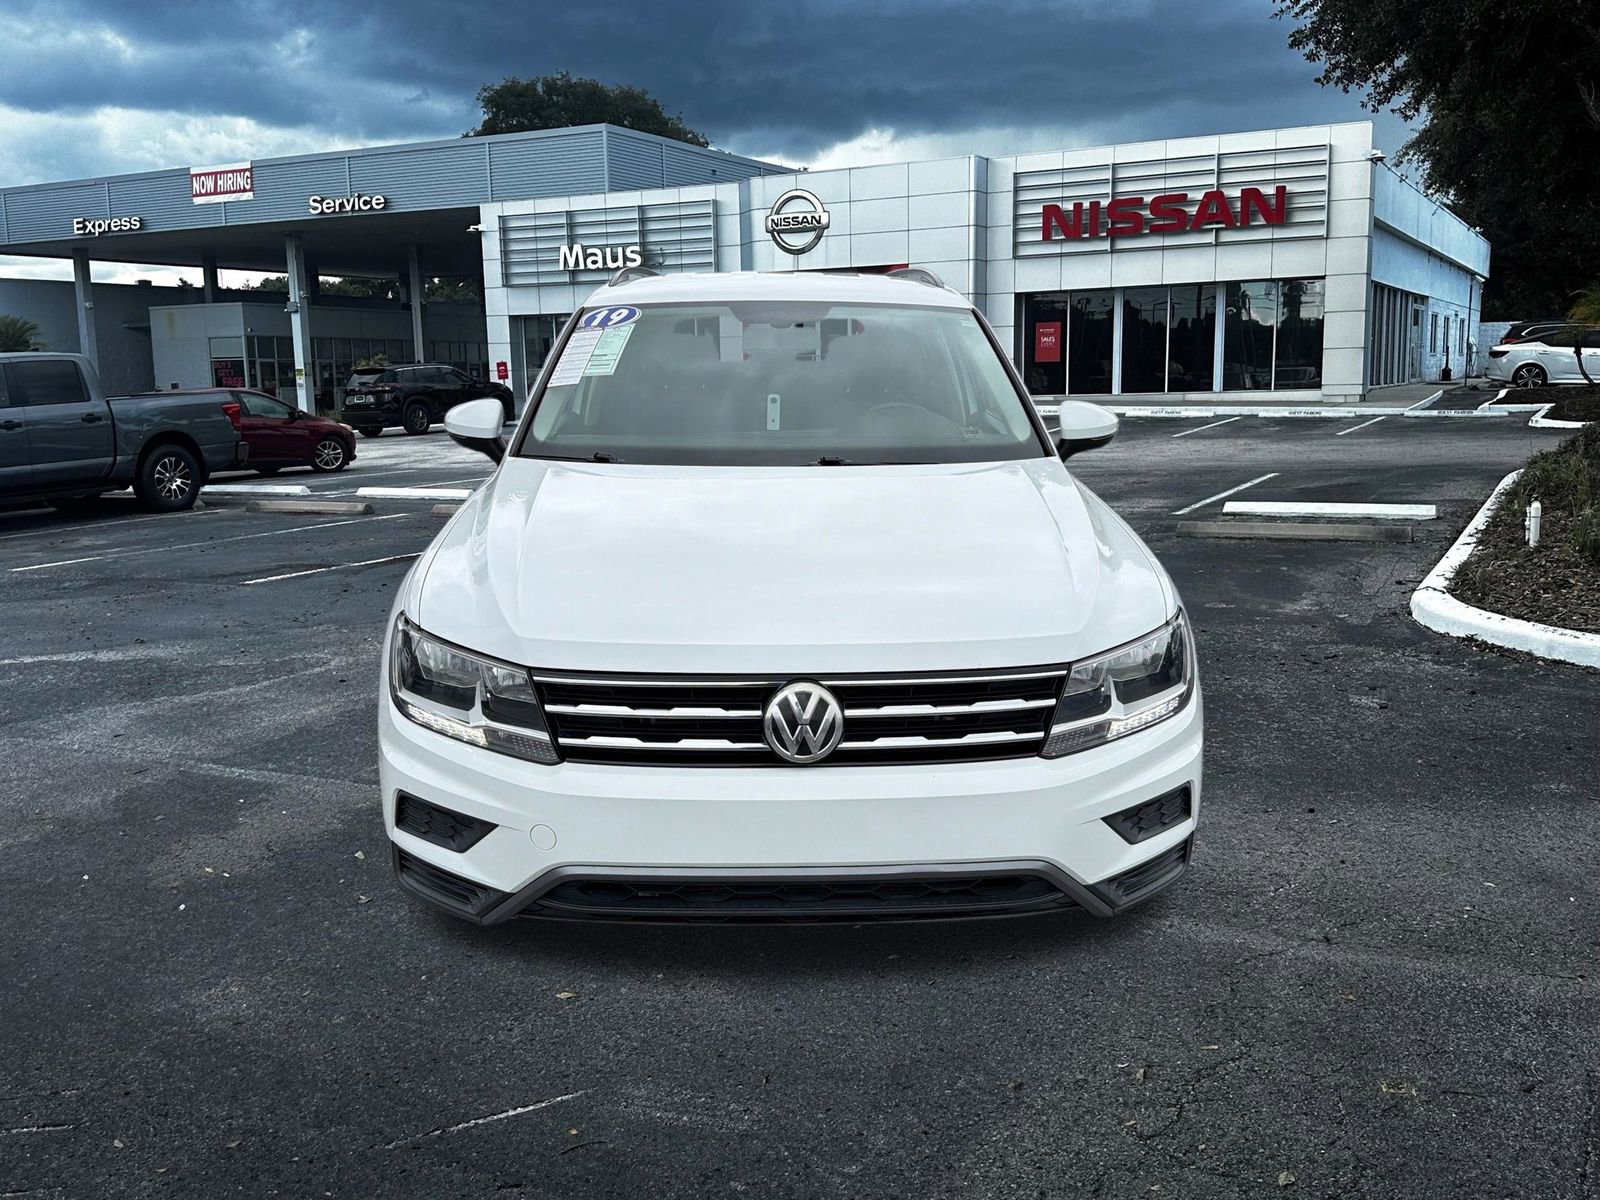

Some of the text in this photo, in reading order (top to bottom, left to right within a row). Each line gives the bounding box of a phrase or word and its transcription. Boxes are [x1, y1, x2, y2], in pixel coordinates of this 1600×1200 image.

[192, 171, 251, 195] NOW HIRING
[308, 193, 385, 214] Service
[1042, 185, 1287, 241] NISSAN
[73, 216, 141, 237] Express
[770, 215, 822, 229] NISSAN
[560, 243, 642, 270] Maus
[590, 308, 629, 327] 19
